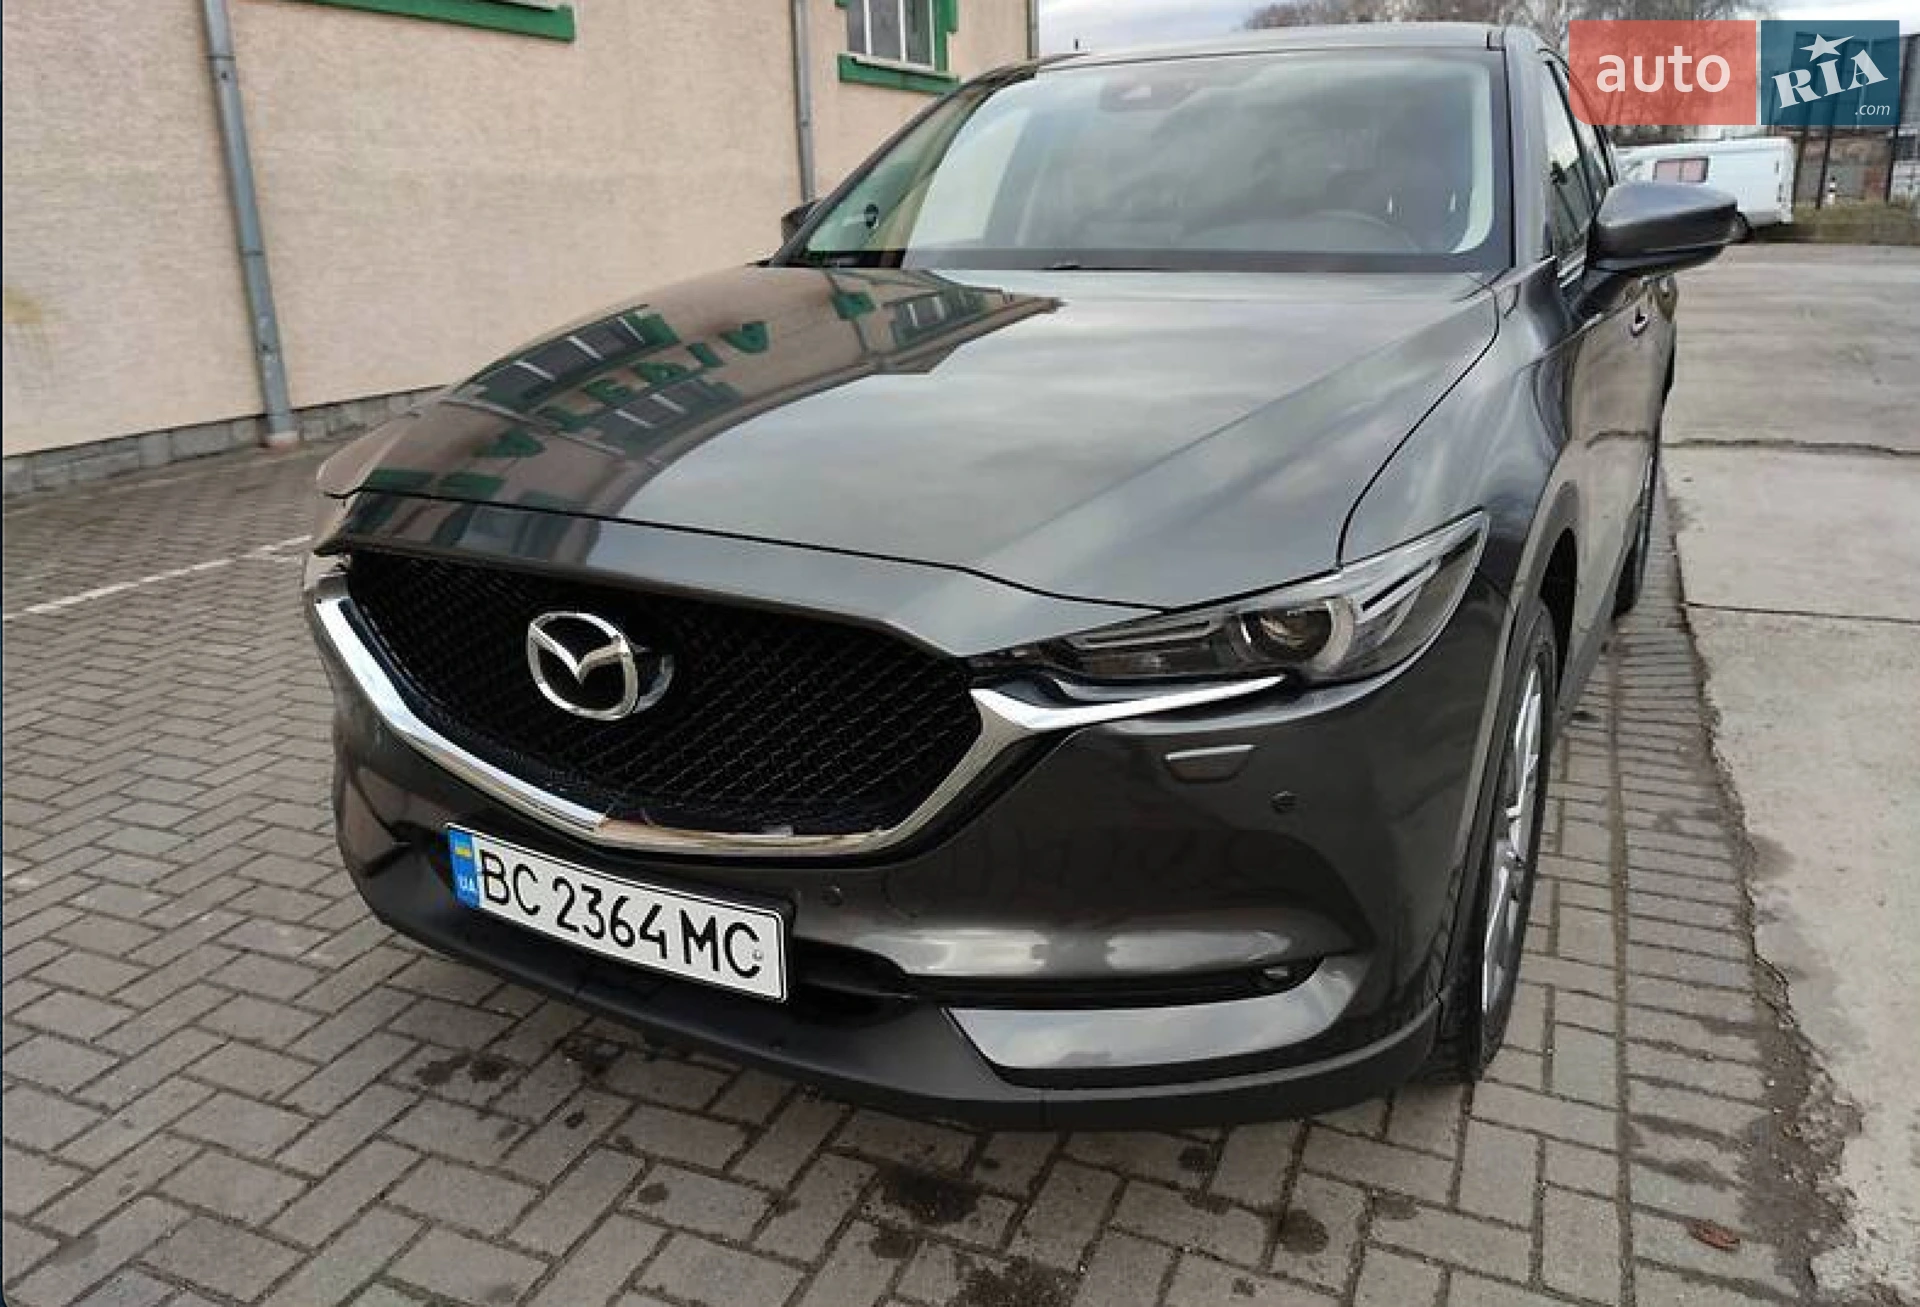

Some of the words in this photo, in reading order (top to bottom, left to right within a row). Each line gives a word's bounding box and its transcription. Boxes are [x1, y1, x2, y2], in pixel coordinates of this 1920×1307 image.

[479, 849, 541, 916] BC
[552, 876, 668, 960] 2364
[680, 909, 760, 979] MC
